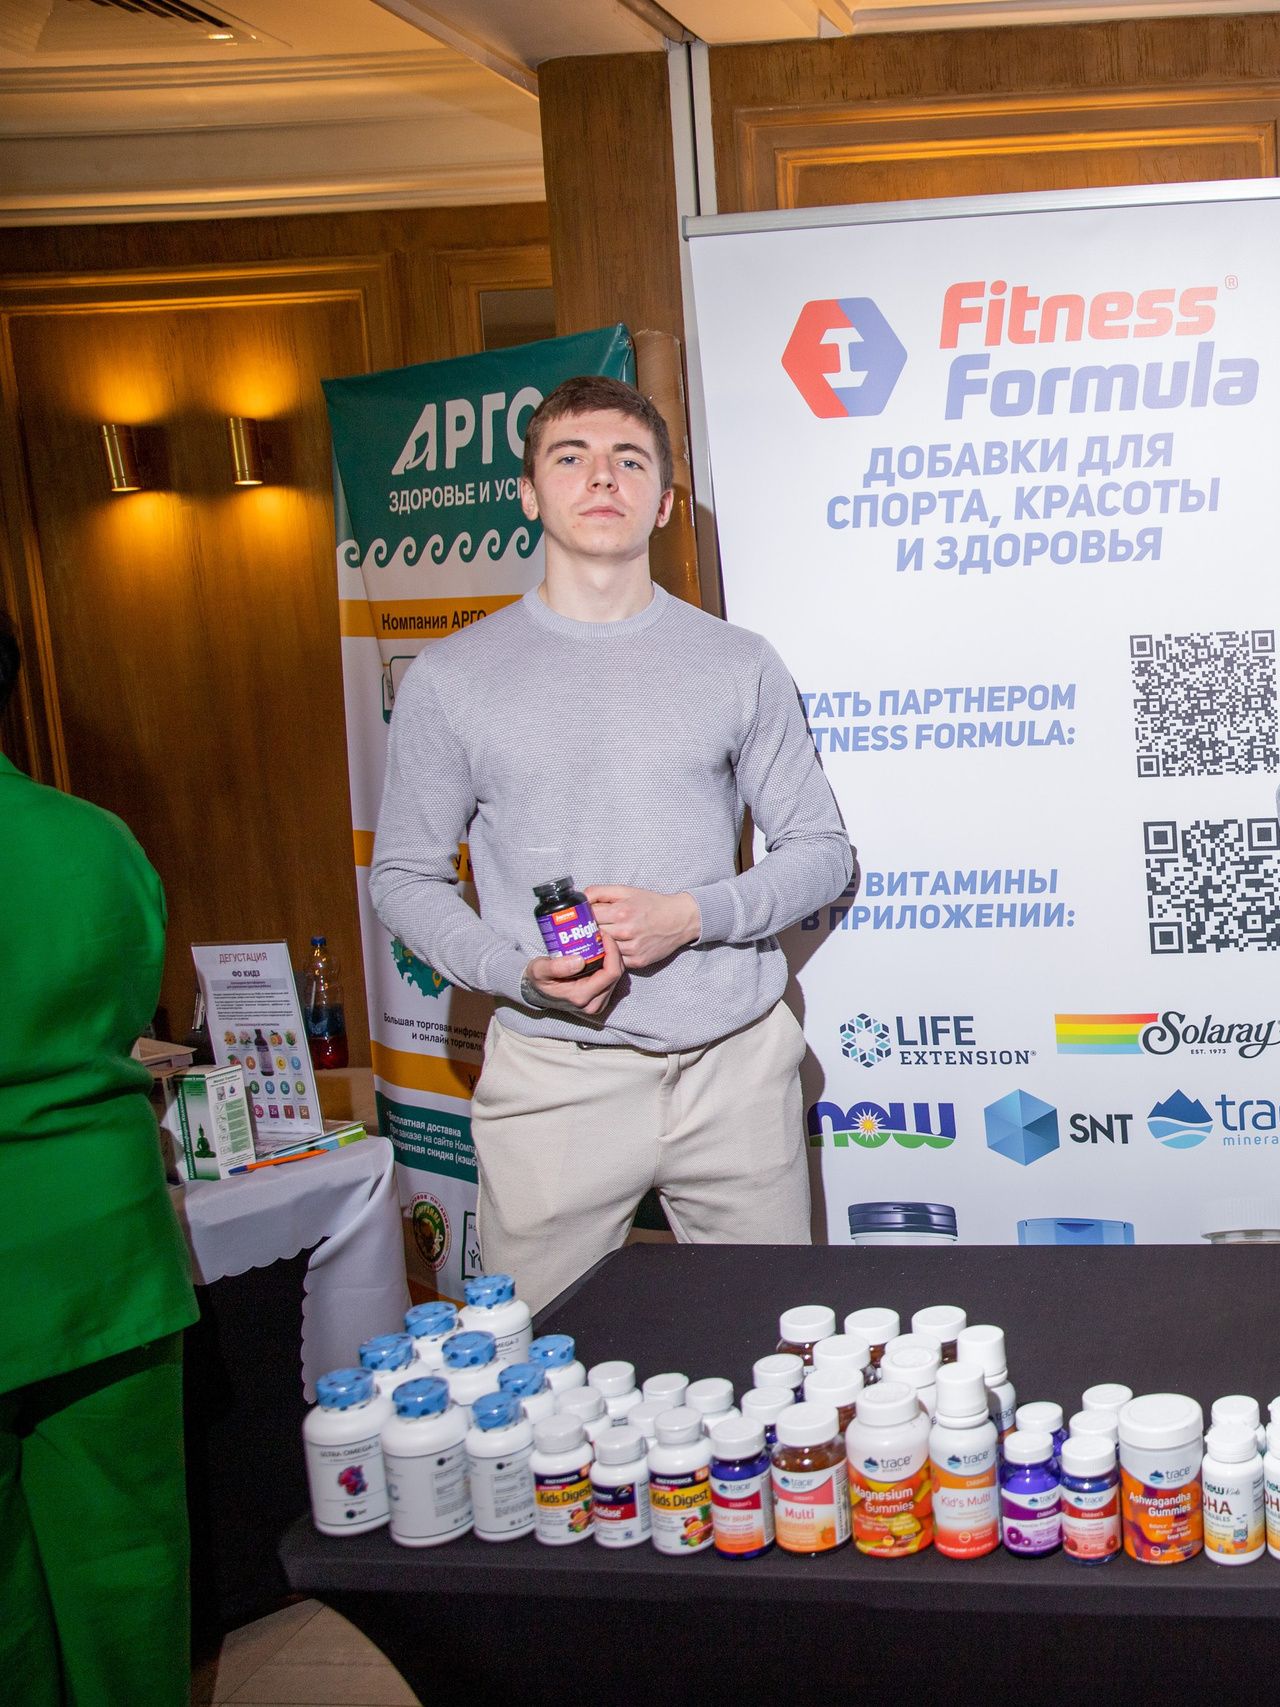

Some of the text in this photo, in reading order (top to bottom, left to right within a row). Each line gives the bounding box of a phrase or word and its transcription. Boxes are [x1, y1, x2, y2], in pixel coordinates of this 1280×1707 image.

[939, 280, 1218, 349] Fitness
[945, 342, 1260, 420] Formula
[863, 432, 1174, 488] ДОБАВКИ ДЛЯ
[389, 482, 490, 515] ЗДОРОВЬЕ И
[826, 477, 1220, 530] СПОРТА, КРАСОТЫ
[897, 527, 1163, 575] И ЗДОРОВЬЯ
[382, 613, 447, 630] Компания
[801, 683, 1077, 719] ТАТЬ ПАРТНЕРОМ
[810, 719, 1075, 753] TNESS FORMULA:
[865, 868, 1058, 897] ВИТАМИНЫ
[801, 902, 1075, 931] В ПРИЛОЖЕНИИ:
[558, 920, 599, 944] B-Righ
[220, 953, 267, 964] ДЕГУСТАЦИЯ
[384, 1013, 452, 1032] Большая торговая
[896, 1015, 977, 1046] LIFE
[419, 1032, 448, 1044] онлайн
[900, 1050, 1029, 1066] EXTENSION
[1209, 1047, 1227, 1055] 1973
[427, 1123, 461, 1137] доставка
[807, 1100, 957, 1149] now
[1069, 1113, 1133, 1145] SNT
[434, 1136, 453, 1147] сайте
[427, 1146, 453, 1160] скидка
[880, 1457, 910, 1469] trace
[963, 1452, 989, 1464] trace
[791, 1478, 813, 1486] trace
[1166, 1467, 1190, 1480] trace
[540, 1490, 560, 1504] Kids
[562, 1483, 592, 1502] Digest
[652, 1490, 708, 1508] Kids Digest
[853, 1483, 913, 1501] Magnesium
[941, 1493, 990, 1508] Kid's Multi
[1129, 1491, 1191, 1507] Ashwagandha
[785, 1507, 814, 1519] Multi
[865, 1501, 914, 1513] Gummies
[1148, 1503, 1191, 1517] Gummies
